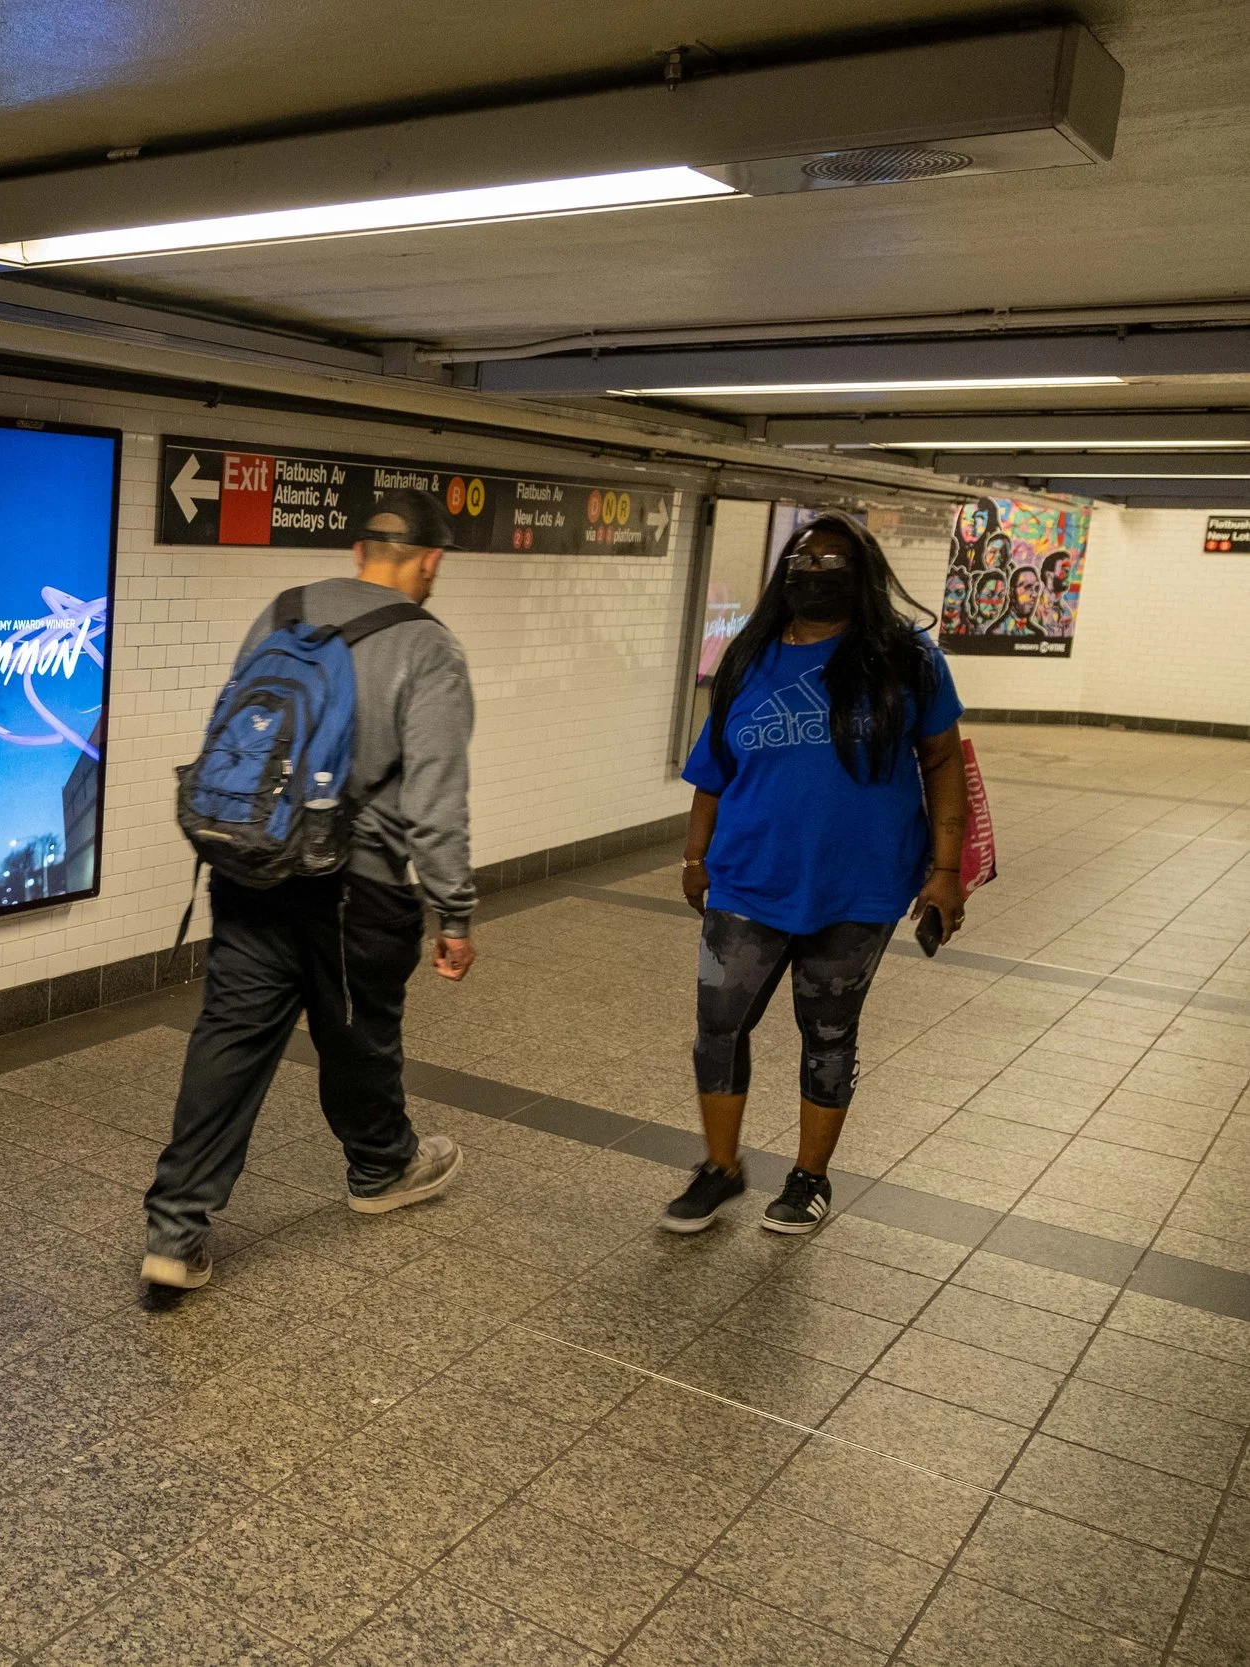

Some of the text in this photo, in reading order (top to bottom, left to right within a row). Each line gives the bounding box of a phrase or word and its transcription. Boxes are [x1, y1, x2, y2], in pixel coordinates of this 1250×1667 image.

[224, 456, 269, 492] Exit
[275, 461, 346, 485] Flatbush Av
[374, 469, 440, 492] Manhattan &
[274, 484, 339, 507] Atlantic Av
[516, 482, 564, 502] Flatbush Av
[272, 507, 348, 532] Barclays Ctr
[514, 509, 566, 528] New Lots Av
[586, 527, 596, 541] via
[613, 528, 641, 544] platform
[1207, 531, 1230, 541] New
[46, 619, 76, 629] WINNER
